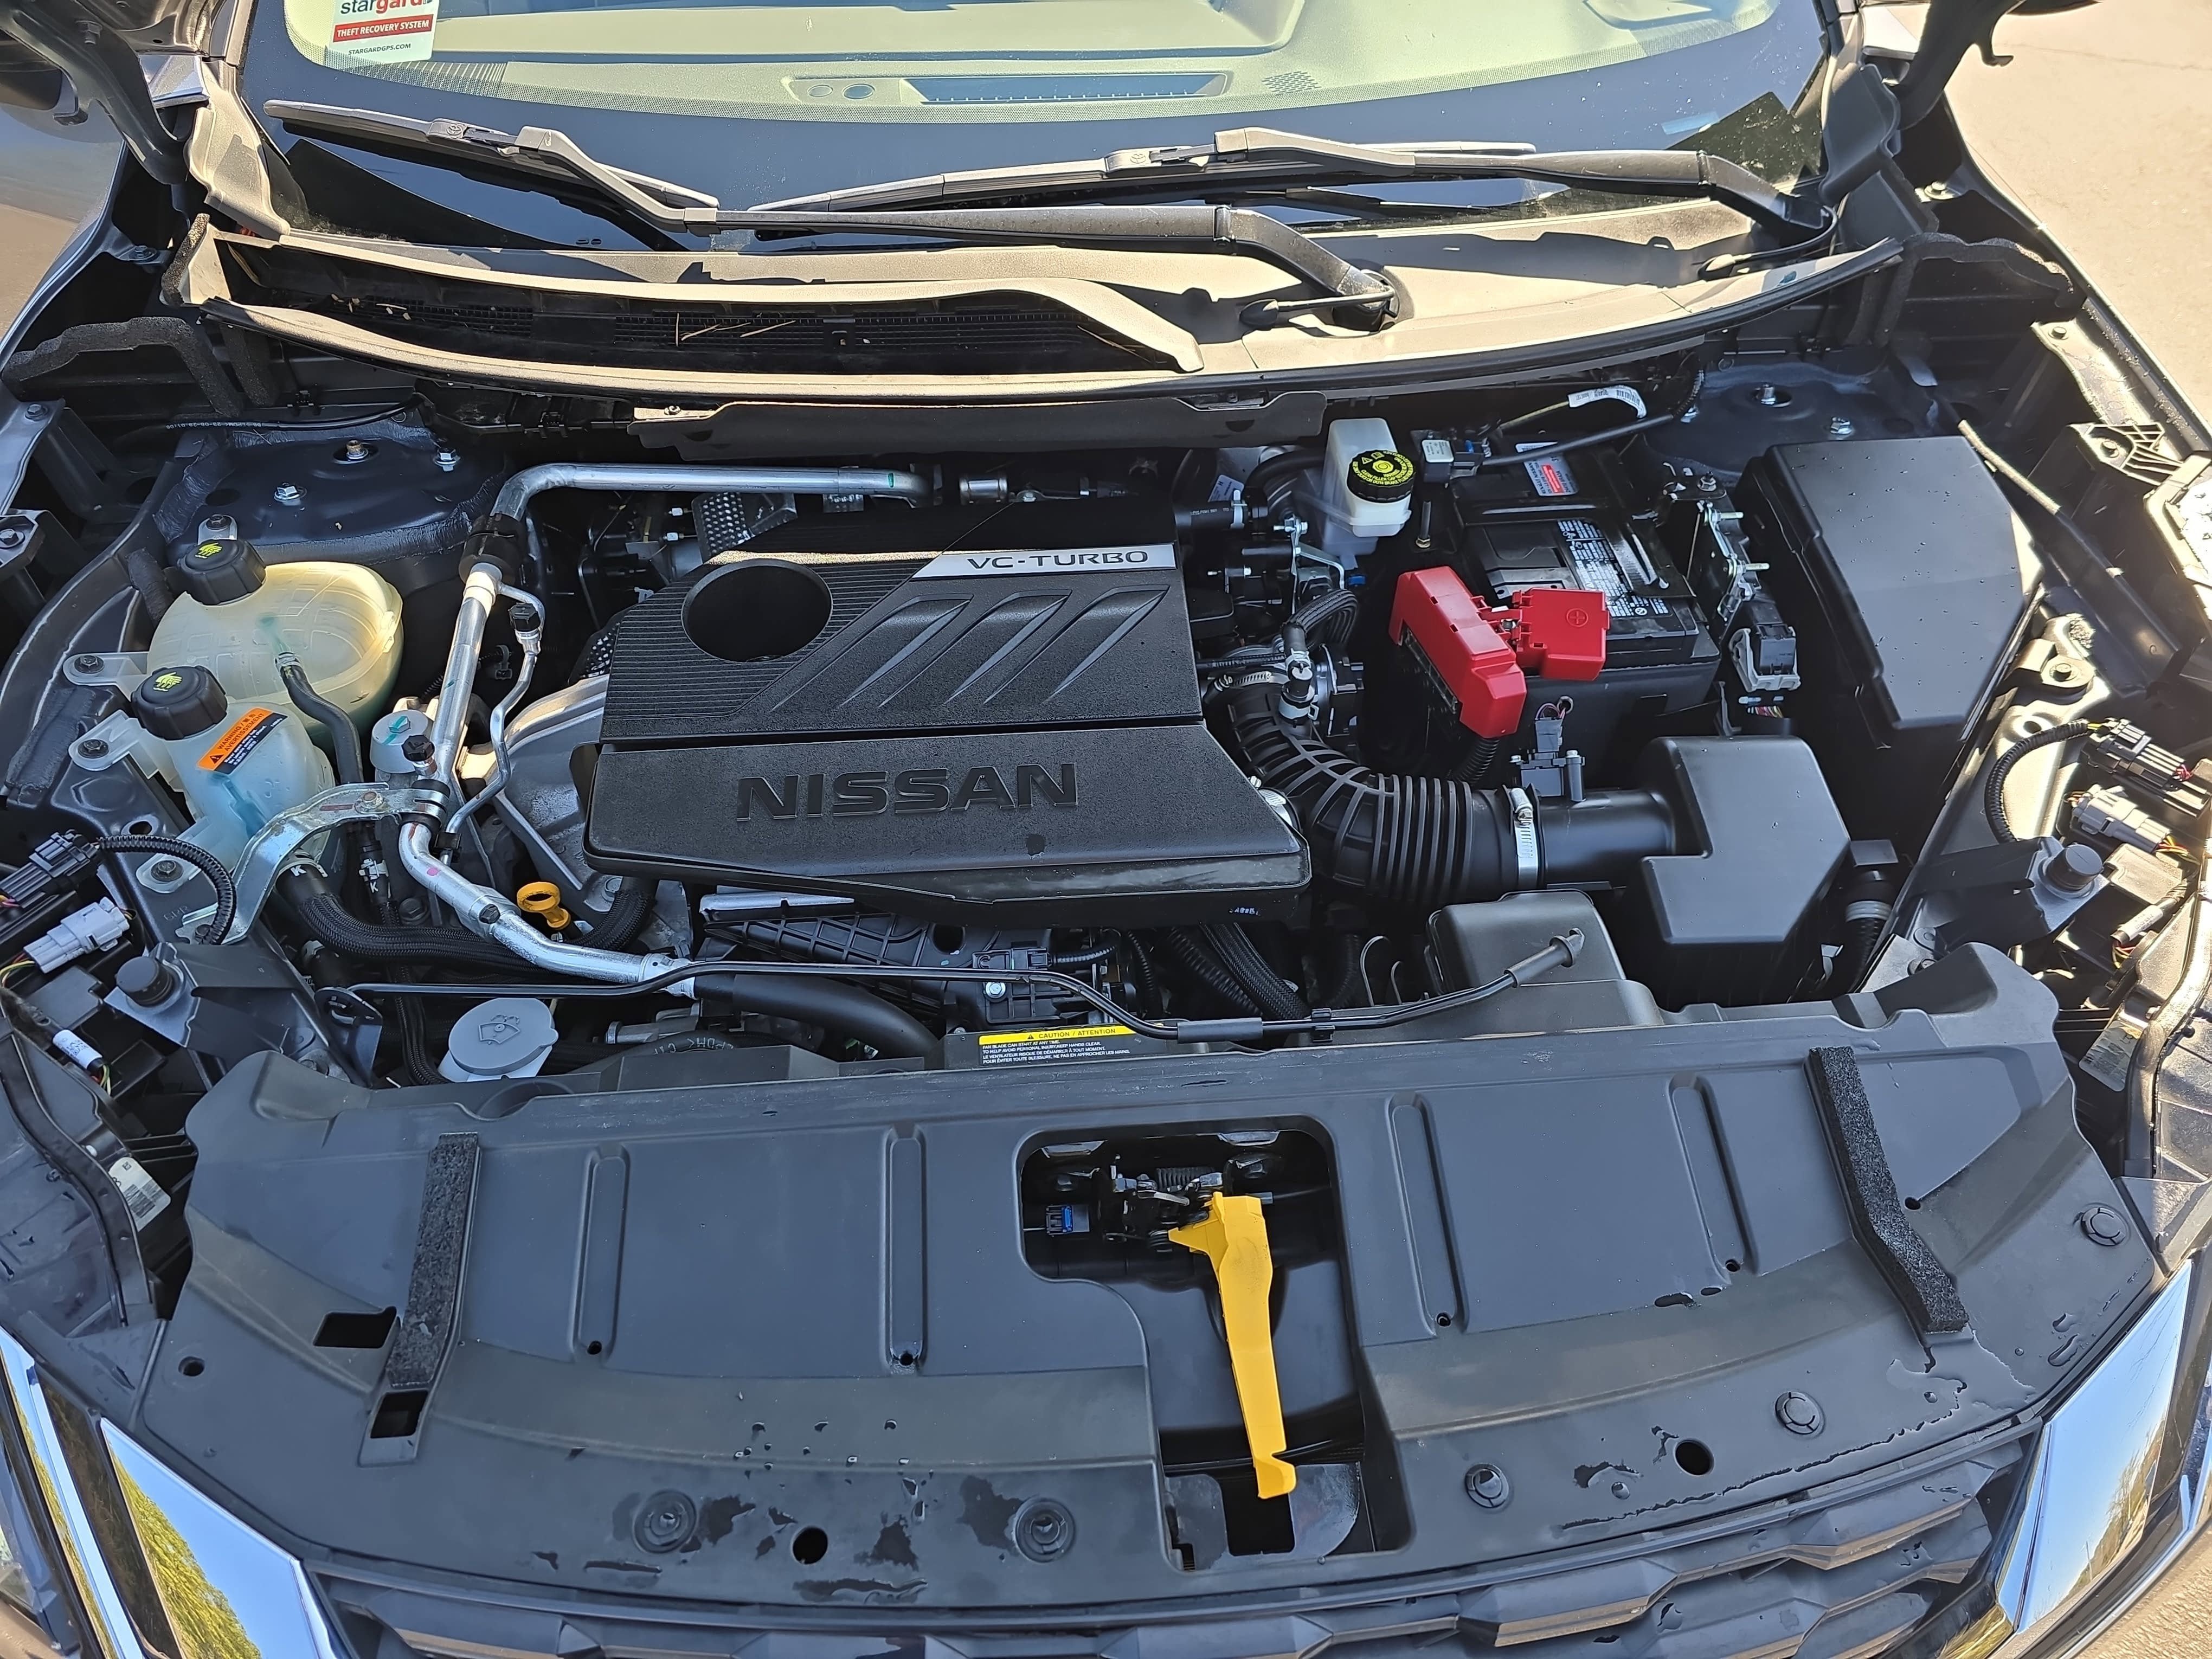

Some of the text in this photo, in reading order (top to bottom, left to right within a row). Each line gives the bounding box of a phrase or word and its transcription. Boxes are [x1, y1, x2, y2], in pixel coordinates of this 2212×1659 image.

[337, 20, 429, 37] THEFT RECOVERY SYSTEM
[348, 43, 411, 55] STARGARDGPS.COM
[967, 551, 1149, 569] VC-TURBO
[217, 726, 242, 750] WARNING
[225, 713, 265, 751] AVERTISSEMENT
[736, 763, 1078, 822] NISSAN
[290, 865, 307, 877] K
[370, 881, 378, 893] K
